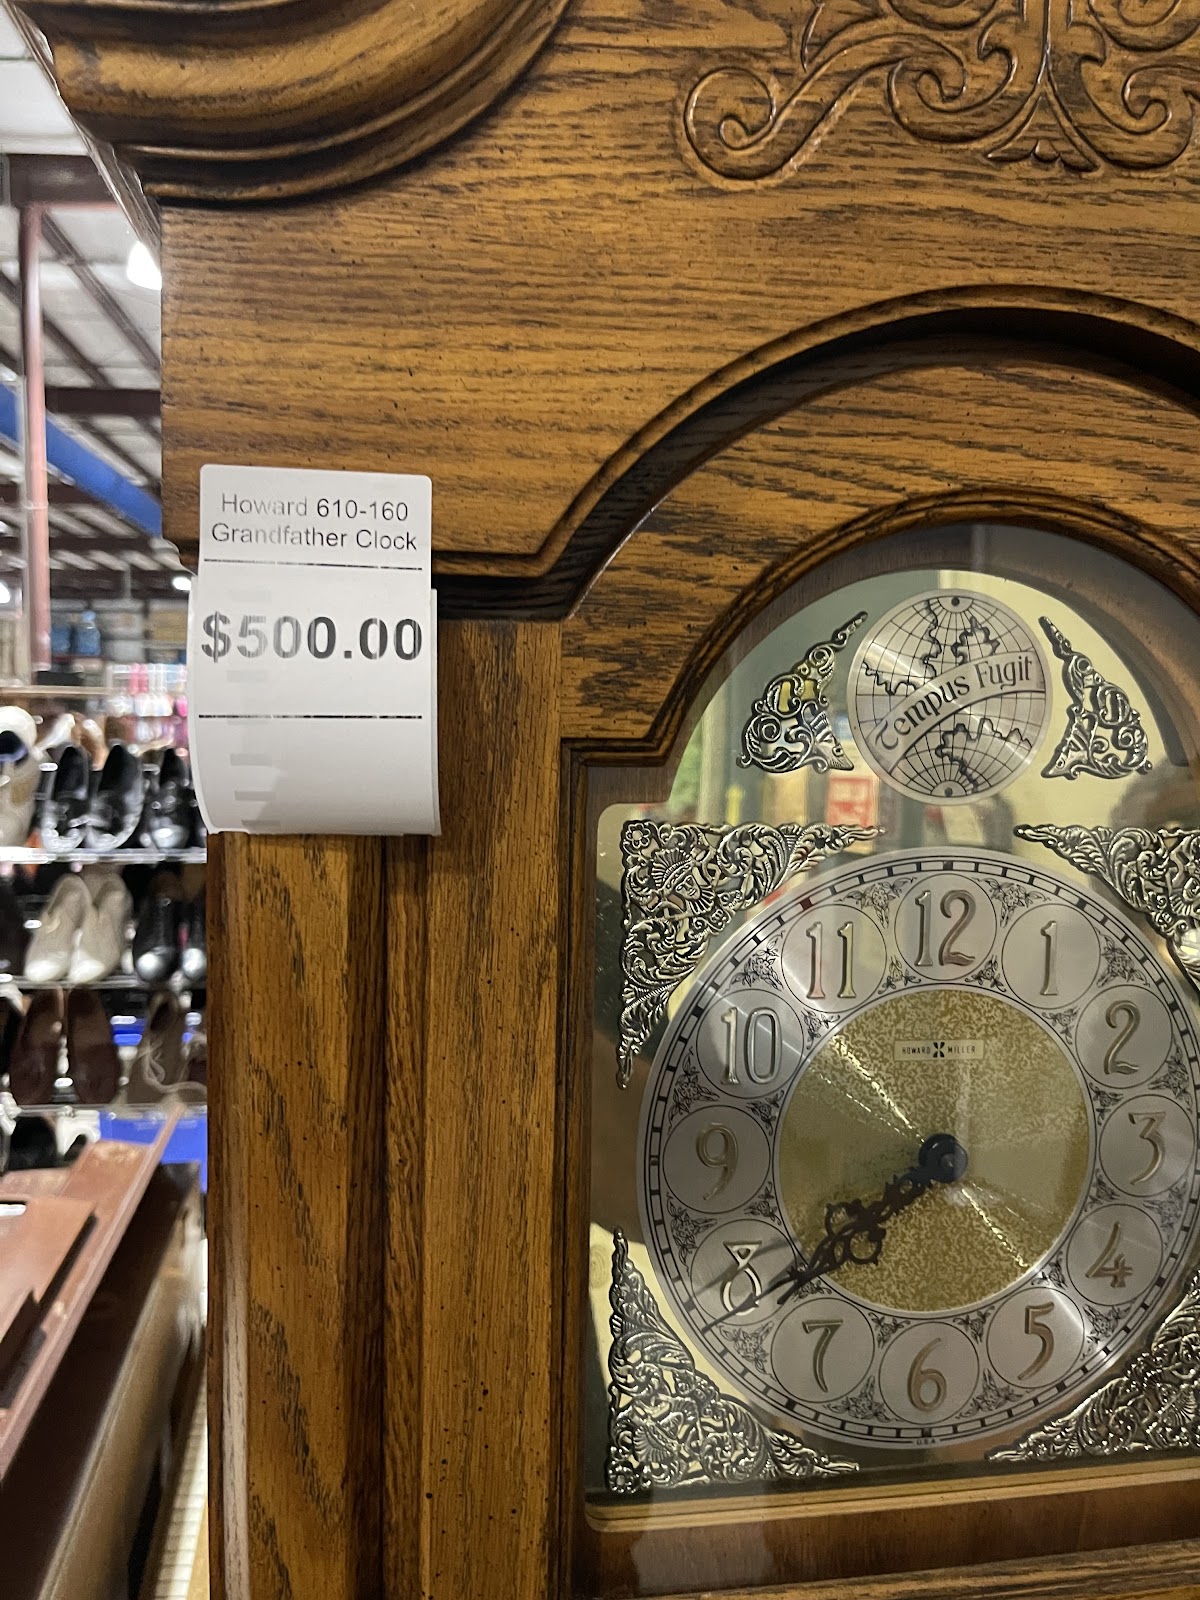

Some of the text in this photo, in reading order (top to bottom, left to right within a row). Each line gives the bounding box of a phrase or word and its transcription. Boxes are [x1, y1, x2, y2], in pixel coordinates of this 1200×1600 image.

[211, 522, 418, 551] Grandfather Clock
[221, 493, 409, 522] Howard 610-160
[201, 611, 423, 663] $500.00
[973, 655, 1033, 690] Fugit
[803, 920, 856, 1000] 11
[913, 889, 976, 968] 12
[1039, 920, 1060, 996] 1
[719, 1005, 783, 1085] 10
[902, 1045, 976, 1054] HOWARD MILLER
[1102, 1000, 1142, 1076] 2
[696, 1121, 739, 1200] 9
[1127, 1110, 1167, 1186] 3
[721, 1240, 764, 1316] 8
[1084, 1220, 1134, 1288] 4
[801, 1318, 845, 1393] 7
[906, 1336, 948, 1413] 6
[1016, 1300, 1056, 1381] 5
